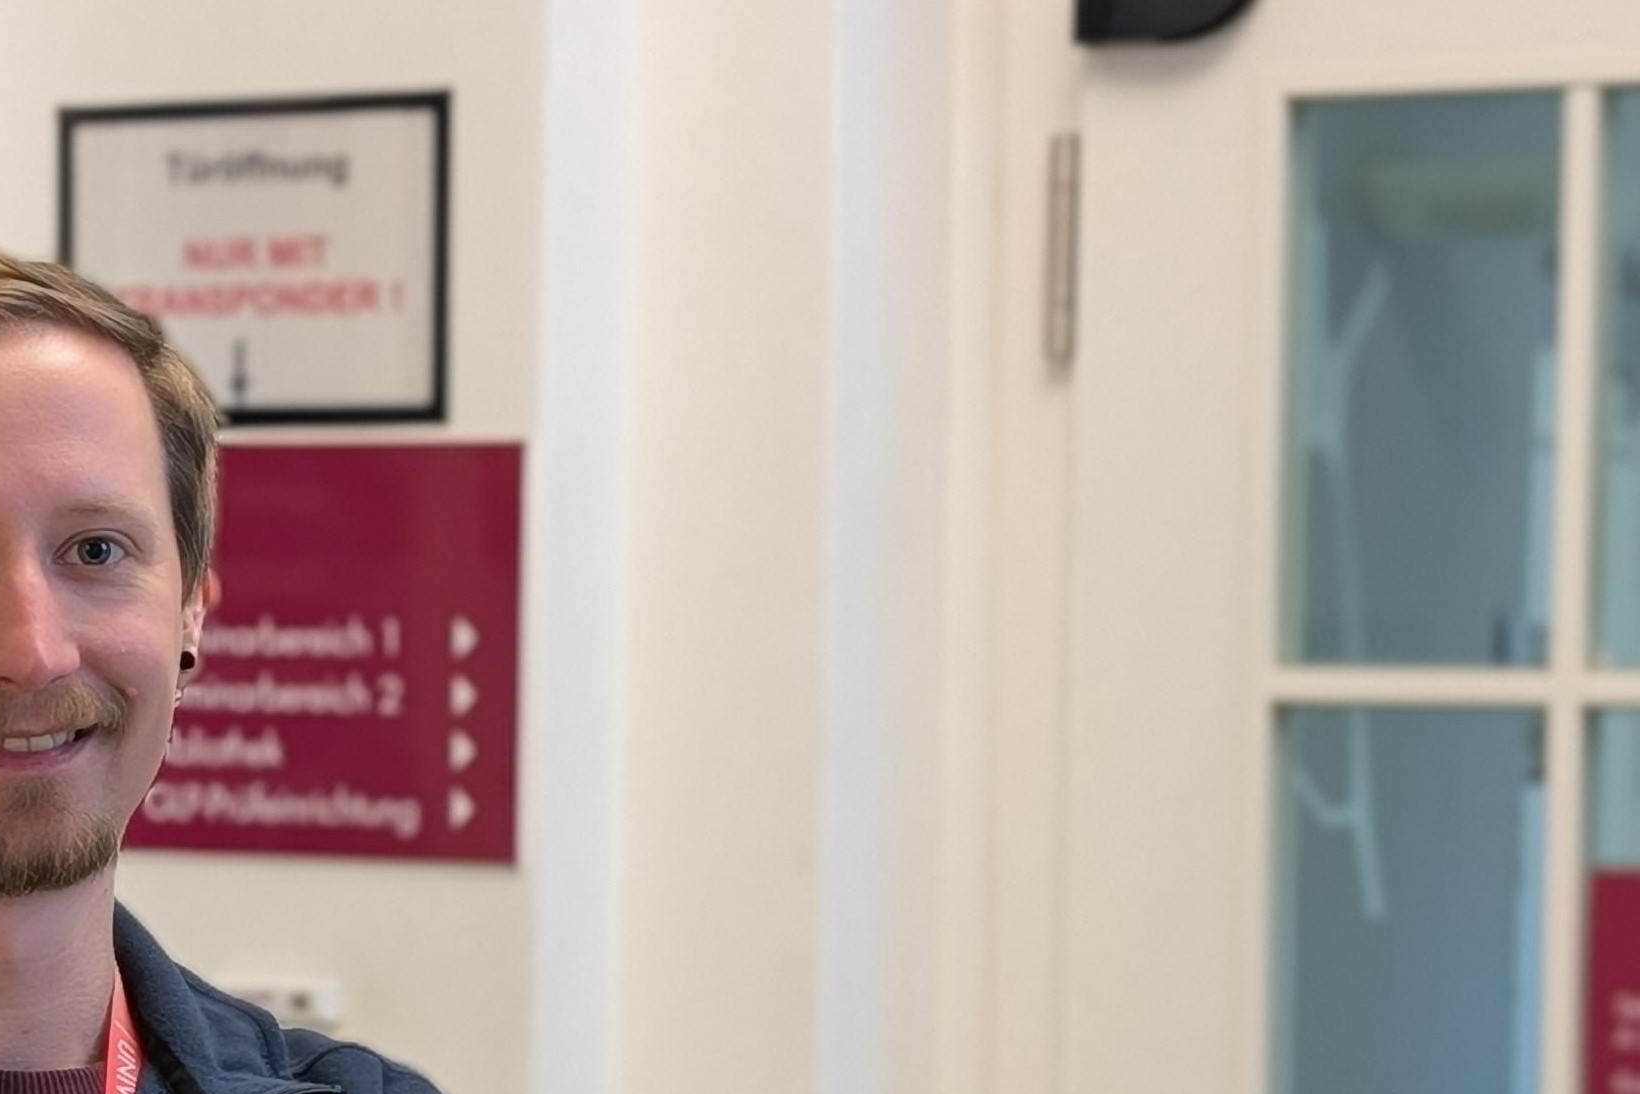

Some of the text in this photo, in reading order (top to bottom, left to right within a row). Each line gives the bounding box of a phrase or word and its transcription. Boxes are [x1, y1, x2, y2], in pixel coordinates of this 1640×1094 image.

[182, 234, 327, 268] NUR MIT
[381, 616, 400, 657] 1
[377, 673, 405, 716] 2
